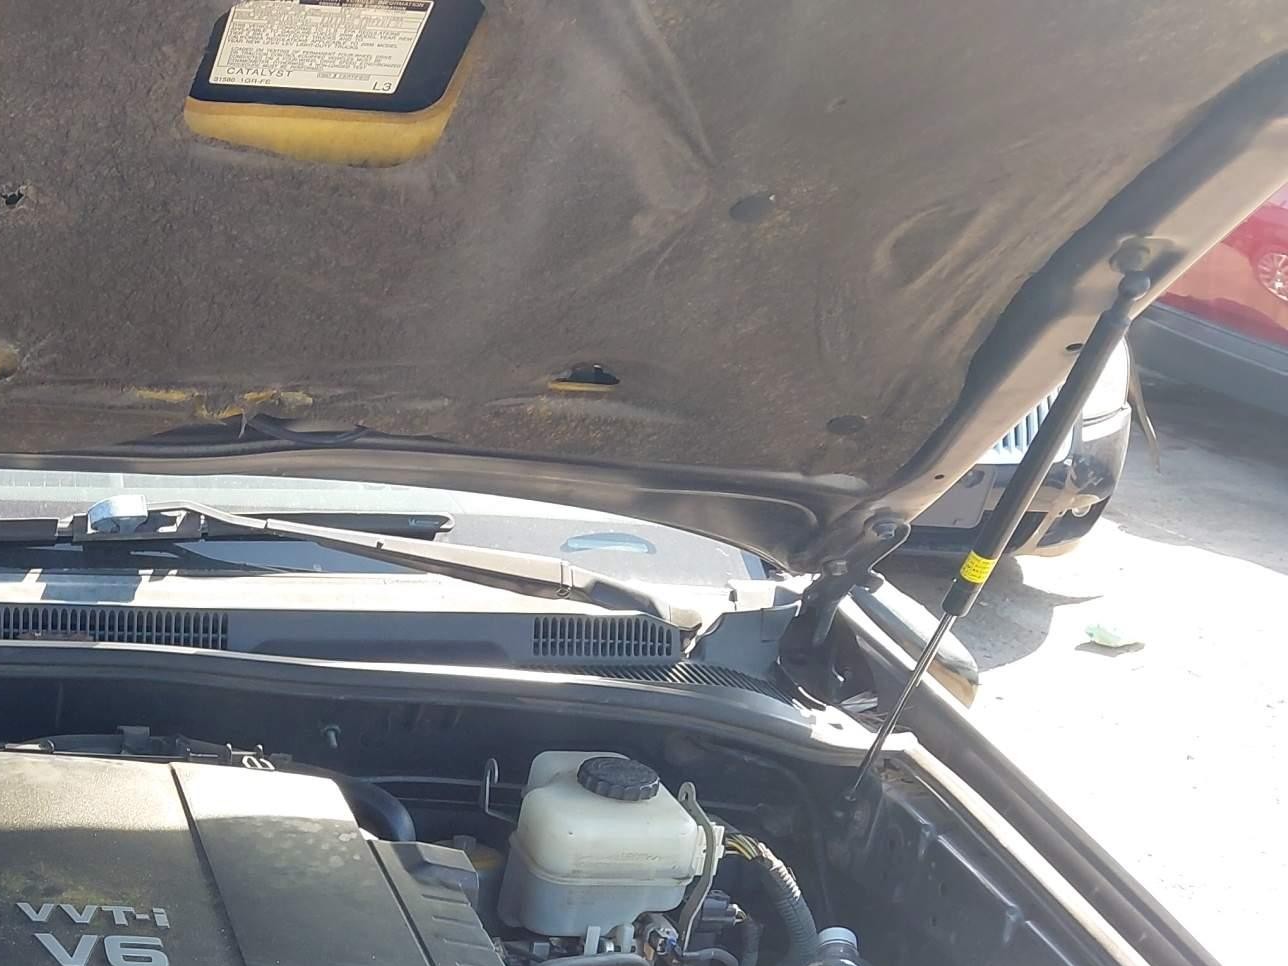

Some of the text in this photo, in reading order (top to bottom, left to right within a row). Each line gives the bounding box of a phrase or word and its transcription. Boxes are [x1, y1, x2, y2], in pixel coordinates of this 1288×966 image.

[226, 67, 293, 77] CATALYST
[372, 81, 393, 92] L3
[16, 902, 171, 928] VVT-i
